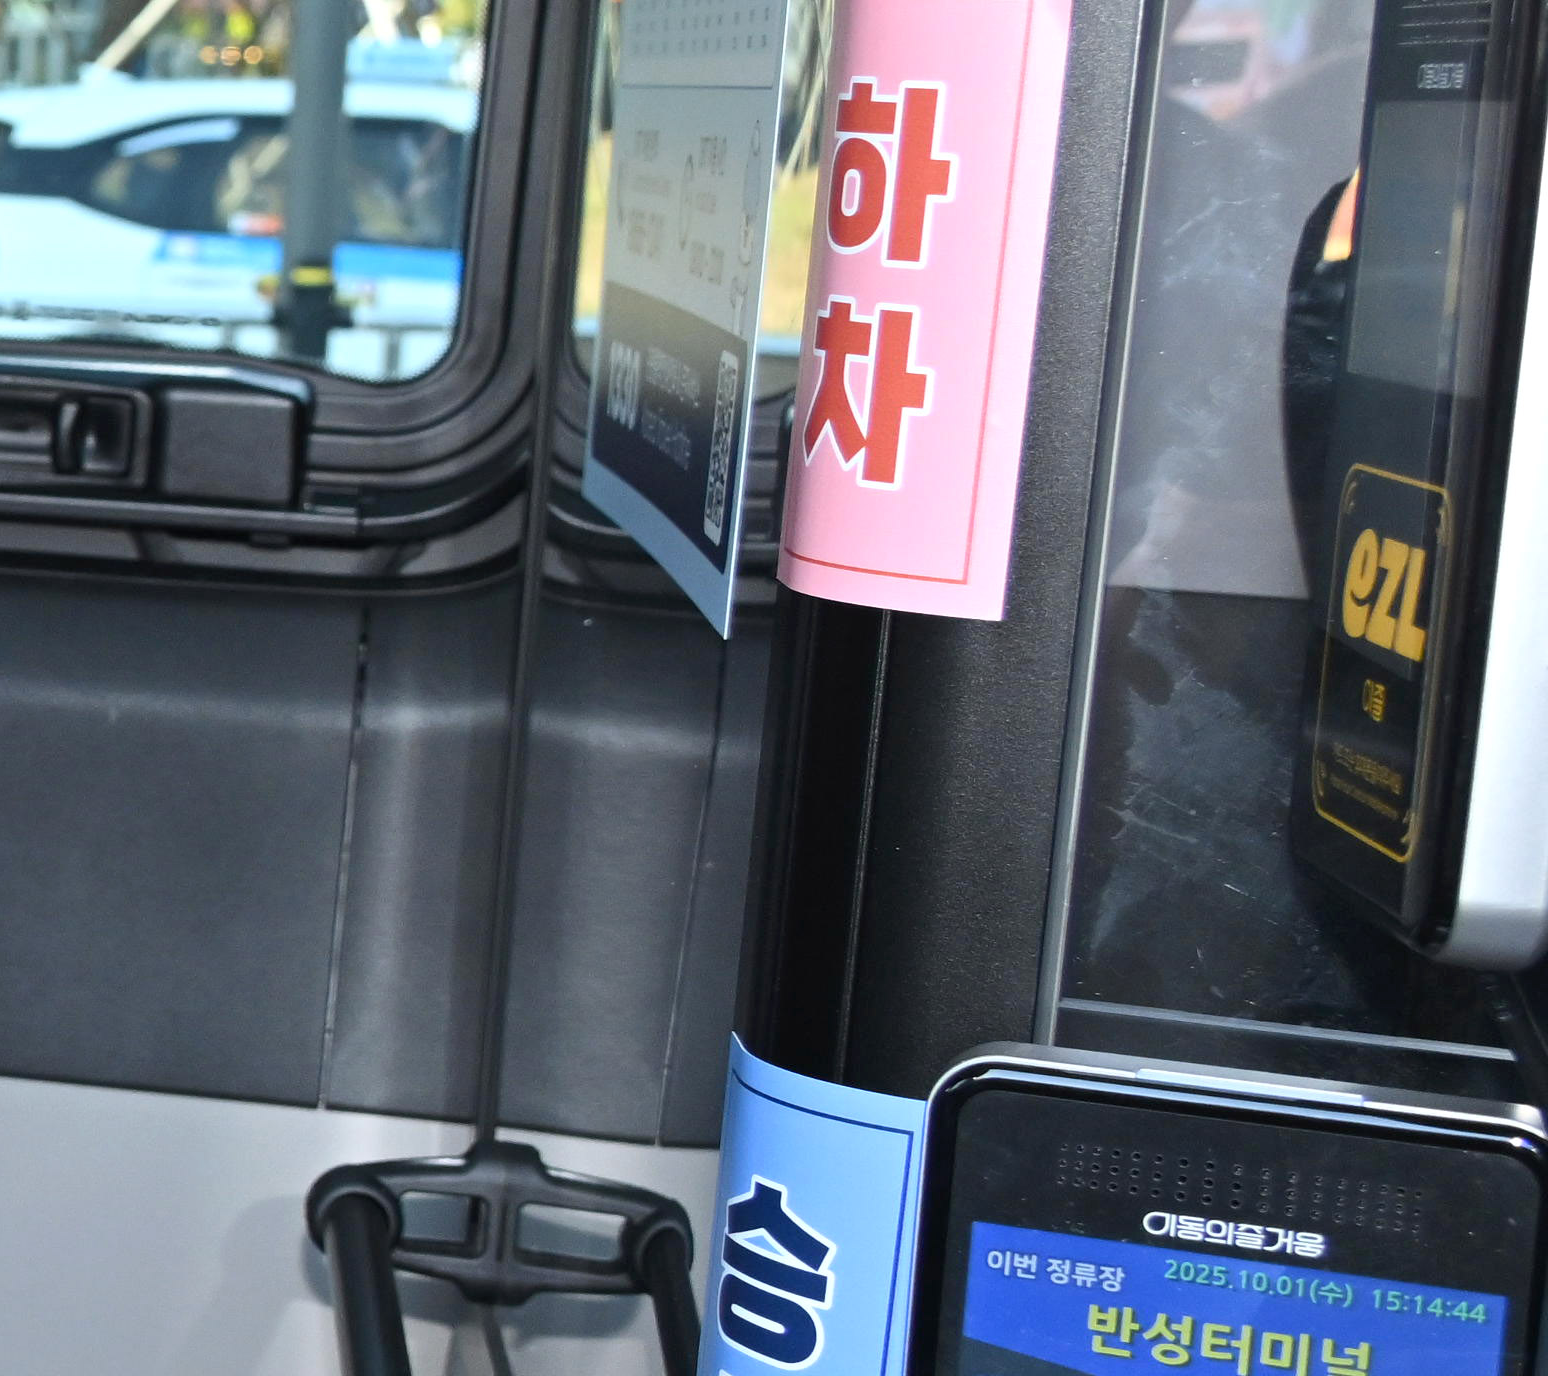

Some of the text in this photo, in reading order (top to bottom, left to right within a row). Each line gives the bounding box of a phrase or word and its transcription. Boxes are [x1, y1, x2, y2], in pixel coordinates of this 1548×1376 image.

[805, 82, 951, 485] 하차
[1143, 1211, 1326, 1258] 이동의즐거움
[987, 1250, 1125, 1293] 이번 정류장
[1164, 1259, 1486, 1323] 2025.10.01(수) 15:14:44
